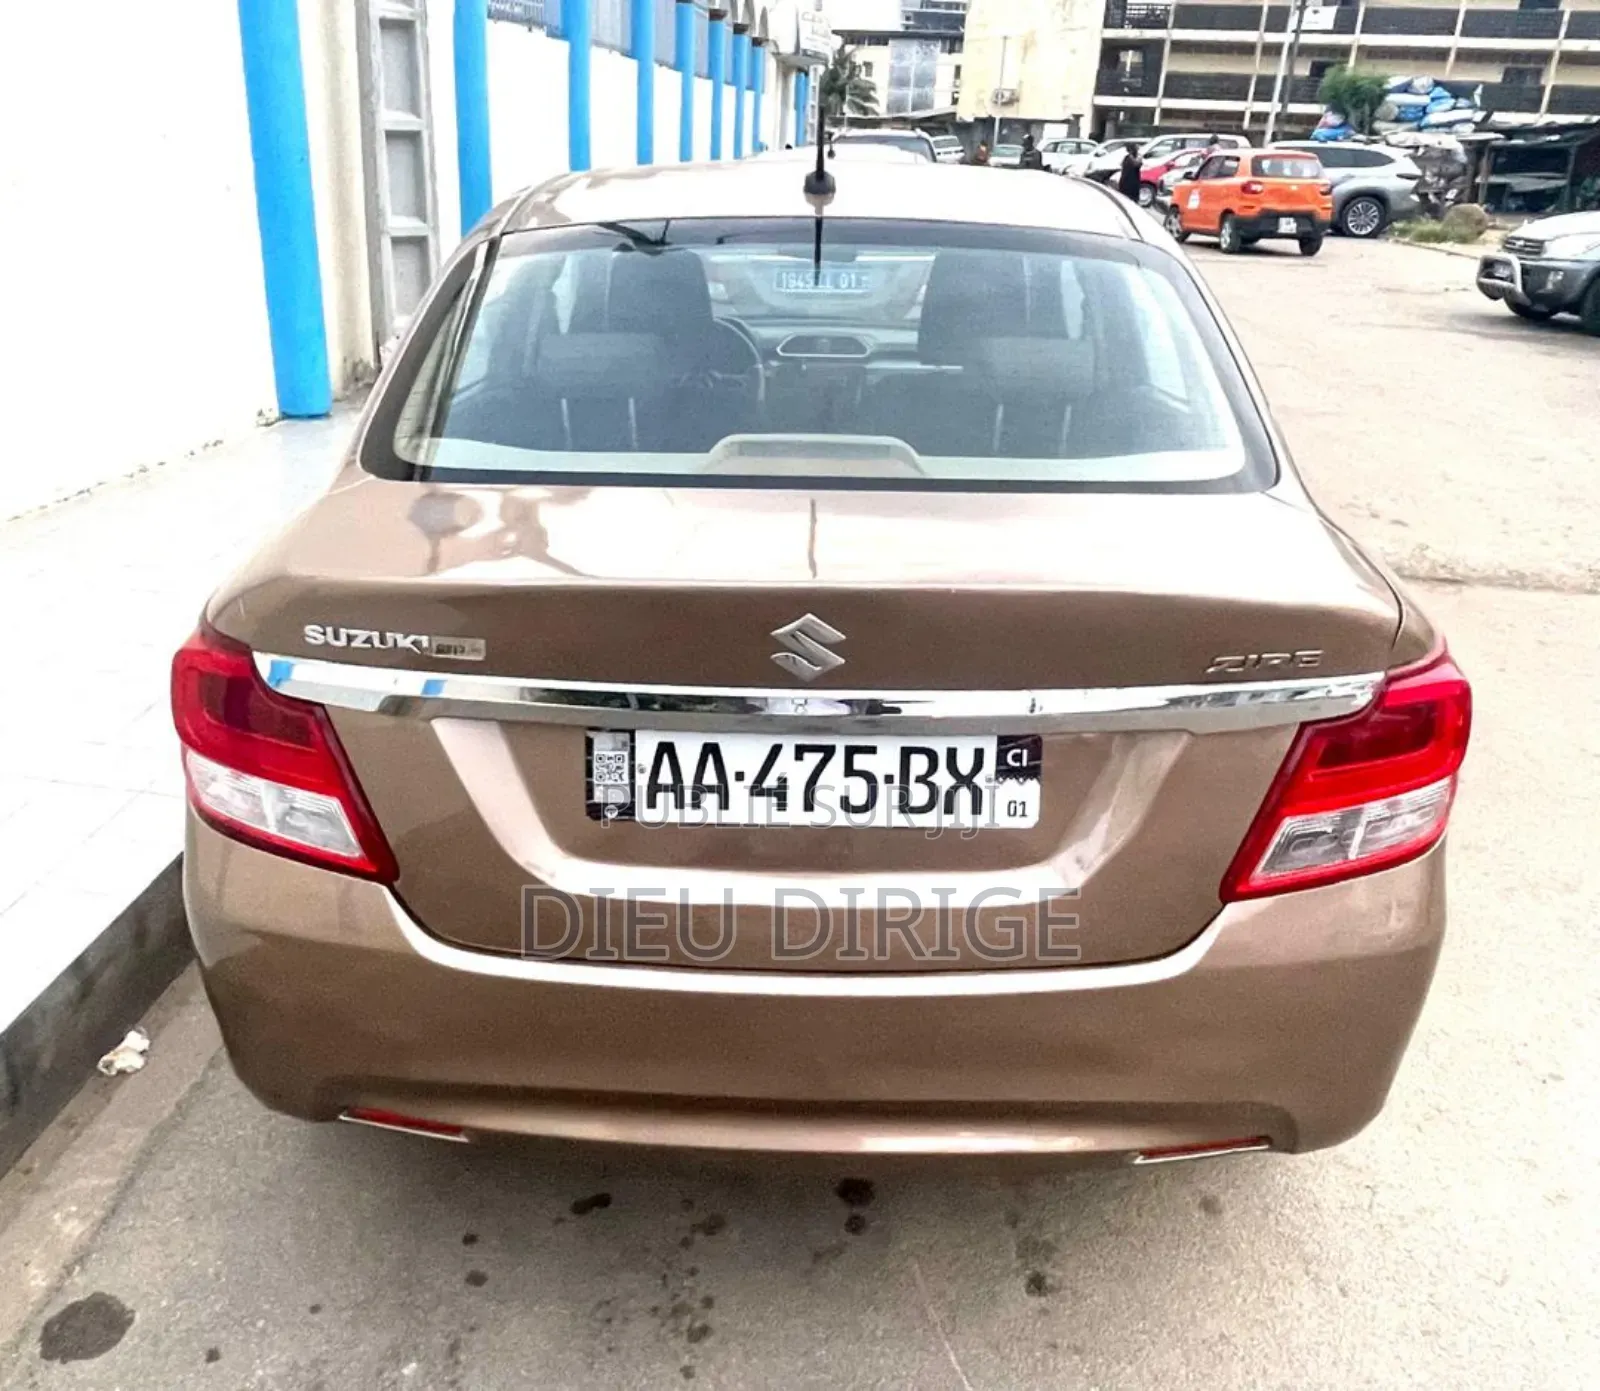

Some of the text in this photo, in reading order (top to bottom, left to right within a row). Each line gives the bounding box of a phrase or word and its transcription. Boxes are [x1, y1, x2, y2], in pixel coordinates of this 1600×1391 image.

[304, 624, 429, 654] SUZUKI
[1006, 748, 1028, 767] CI
[1006, 800, 1028, 818] 01
